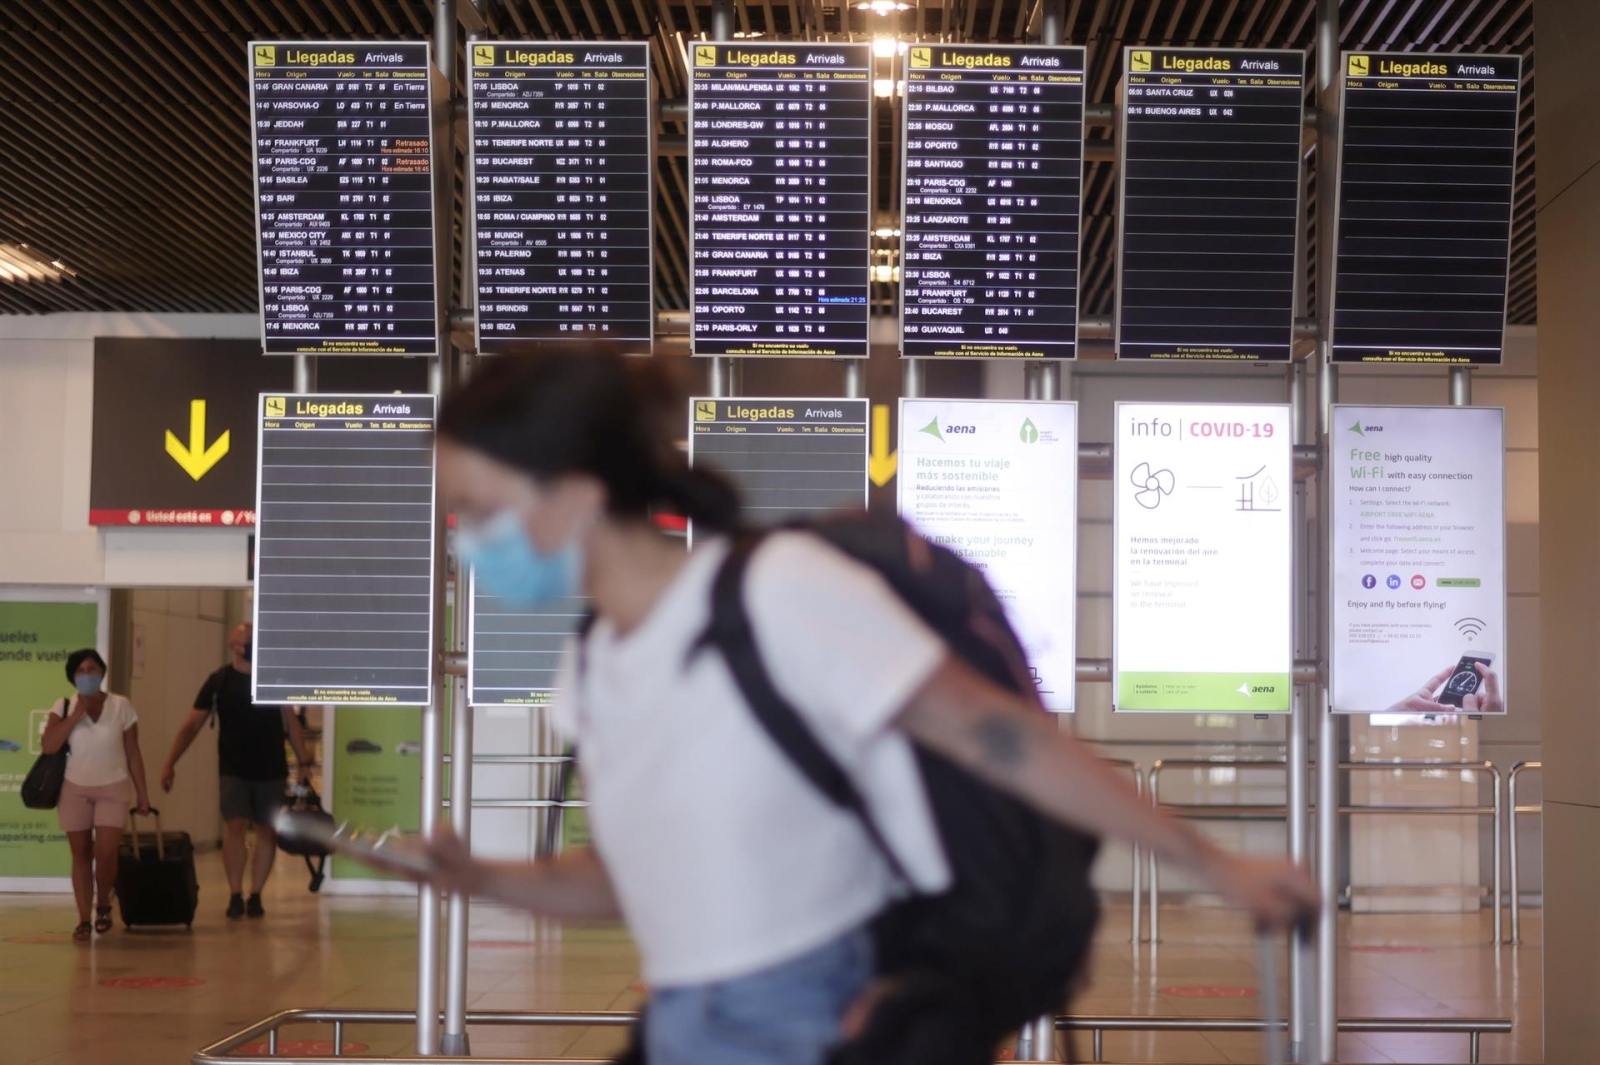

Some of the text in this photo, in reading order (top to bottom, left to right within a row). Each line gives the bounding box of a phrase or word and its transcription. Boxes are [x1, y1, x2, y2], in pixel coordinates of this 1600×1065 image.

[287, 50, 403, 66] Llegadas Arrivals
[506, 50, 622, 66] Llegadas Arrivals
[727, 51, 845, 66] Llegadas Arrivals
[942, 52, 1059, 68] Llegadas Arrivals
[1163, 56, 1279, 72] Llegadas Arrivals
[286, 71, 306, 79] Origen
[1380, 60, 1495, 76] Llegadas Arrivals
[924, 179, 965, 187] PARIS-CDG
[923, 216, 968, 224] LANZAROTE
[921, 326, 964, 334] GUAYAQUIL
[296, 401, 411, 417] Llegadas Arrivals
[727, 406, 842, 421] Llegadas Arrivals
[946, 425, 976, 434] aena
[1131, 418, 1274, 438] info COVID-19
[1350, 449, 1432, 463] Free high quality
[917, 457, 1010, 470] Hacemos tu viaje
[917, 471, 998, 481] más sostenible
[1350, 466, 1383, 479] Wi-Fi
[1408, 473, 1426, 481] easy
[1429, 472, 1473, 480] connection
[935, 534, 1034, 547] make your journey
[1161, 537, 1199, 546] mejorado
[1348, 600, 1368, 609] Enjoy
[1385, 601, 1394, 609] fly
[1424, 601, 1446, 609] flying!
